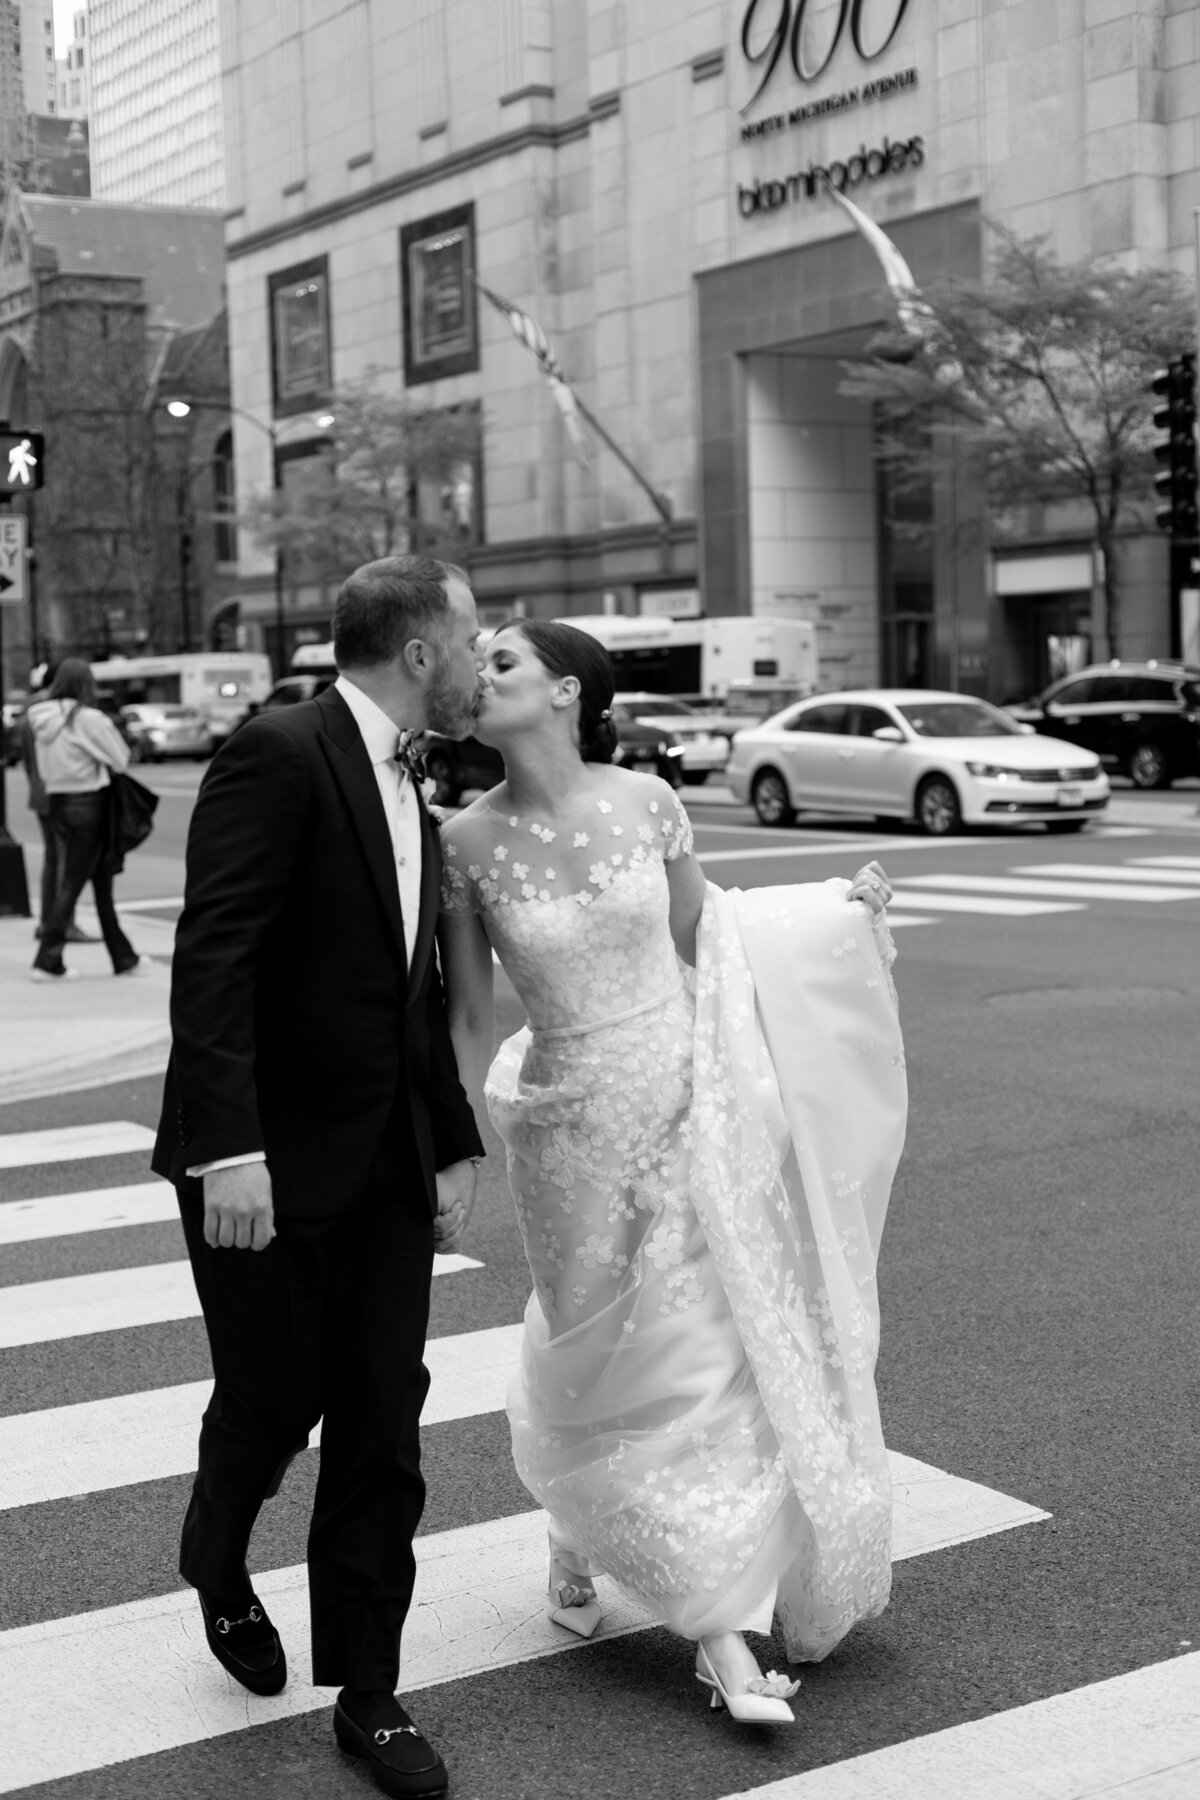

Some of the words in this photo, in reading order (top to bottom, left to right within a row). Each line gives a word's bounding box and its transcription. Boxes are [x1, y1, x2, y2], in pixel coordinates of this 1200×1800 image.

[740, 114, 785, 141] NORTH
[788, 86, 860, 127] MICHIGAN
[861, 65, 919, 103] AVENUE
